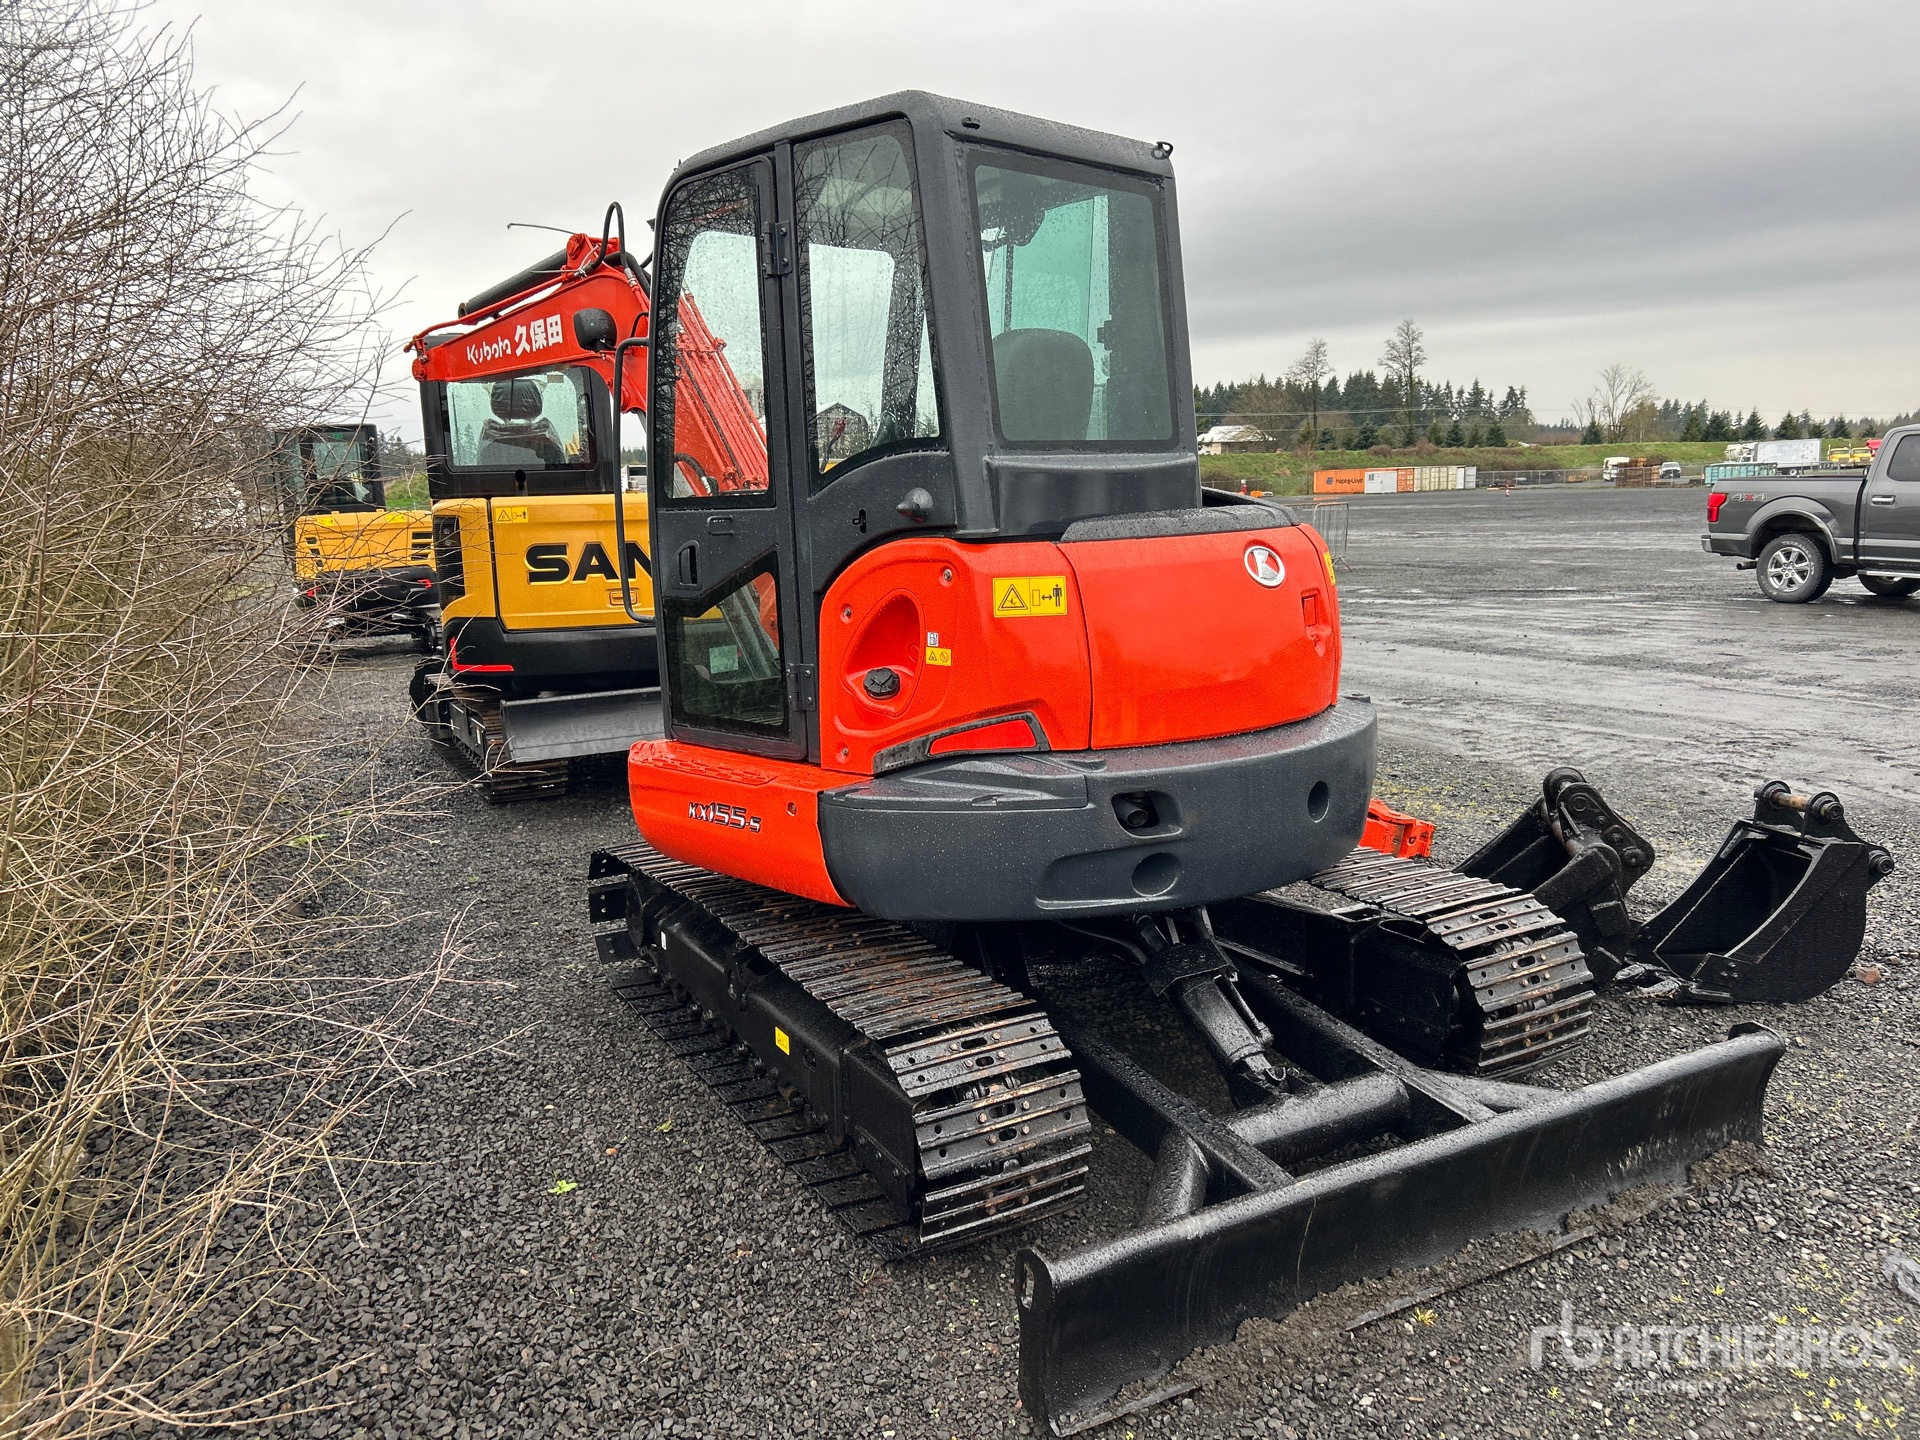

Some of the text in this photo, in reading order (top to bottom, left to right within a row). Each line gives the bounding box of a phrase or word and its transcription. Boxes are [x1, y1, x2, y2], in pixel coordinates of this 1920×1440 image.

[466, 336, 512, 365] Kubota
[514, 314, 563, 357] 久保田
[688, 802, 762, 833] KX155-5
